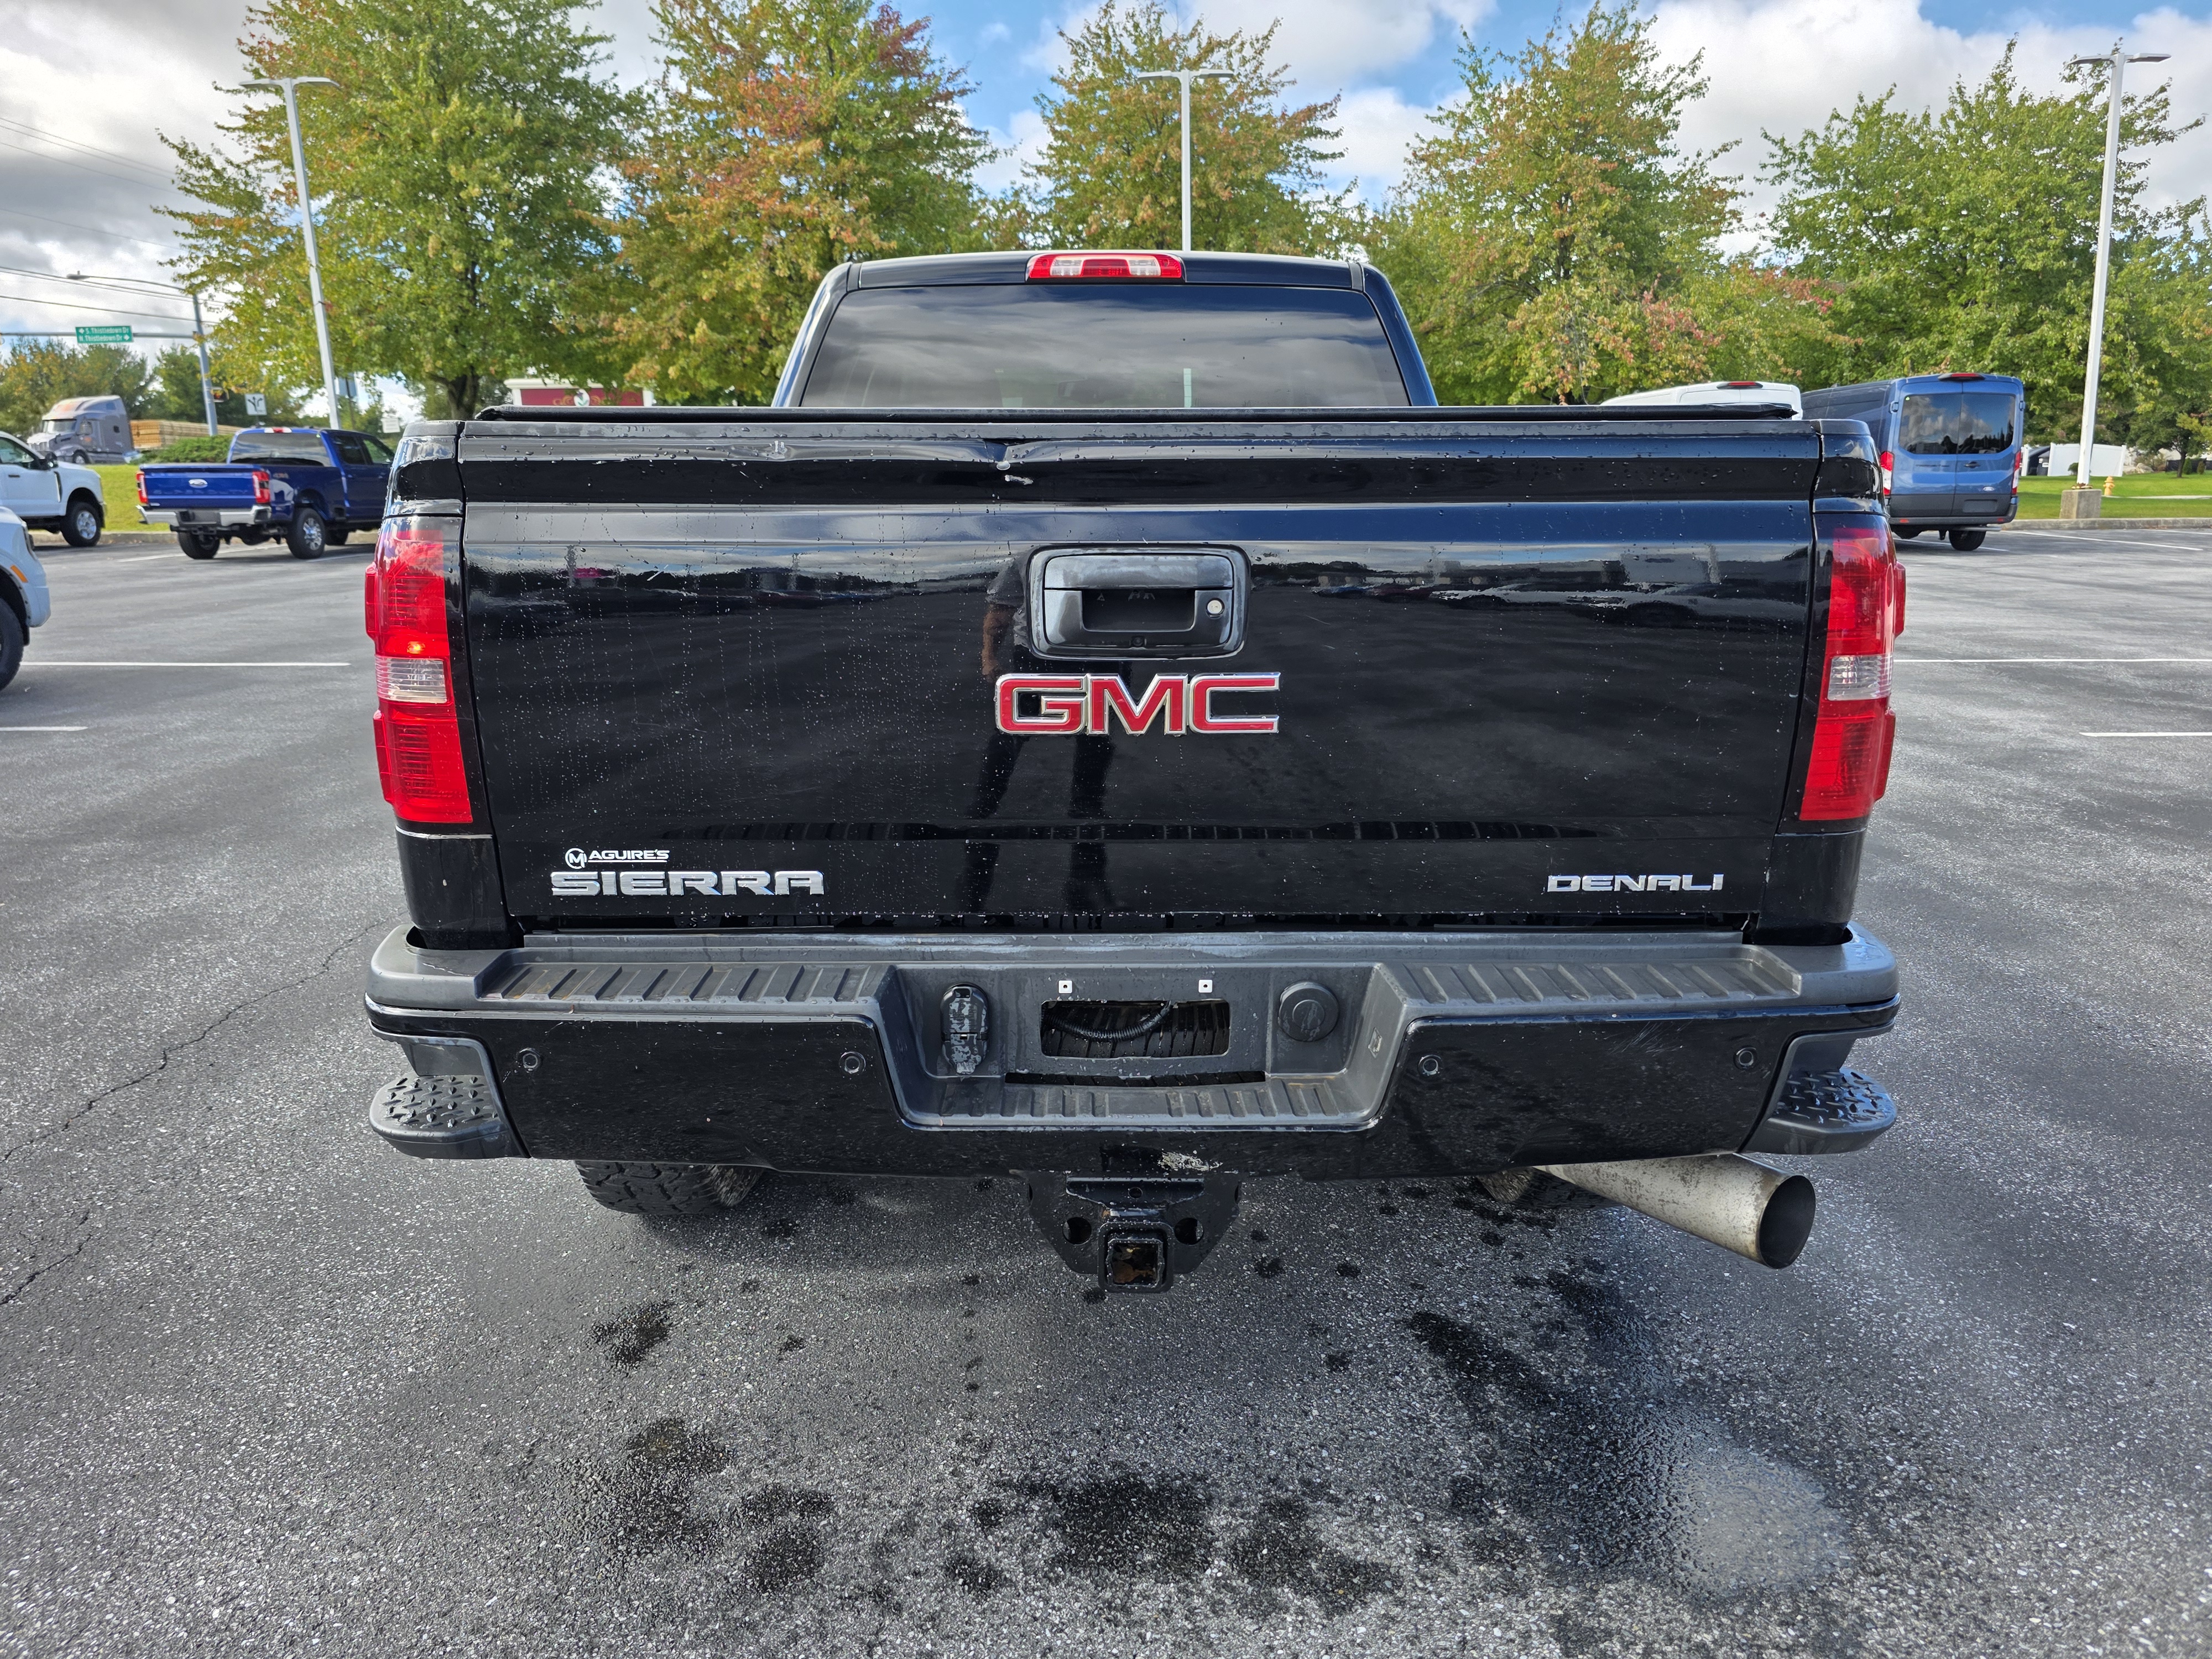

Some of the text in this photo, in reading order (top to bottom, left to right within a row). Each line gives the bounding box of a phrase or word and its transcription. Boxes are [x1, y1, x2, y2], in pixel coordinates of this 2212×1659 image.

[995, 672, 1281, 736] GMC
[550, 871, 824, 896] SIERRA
[1547, 874, 1724, 892] DENALI
